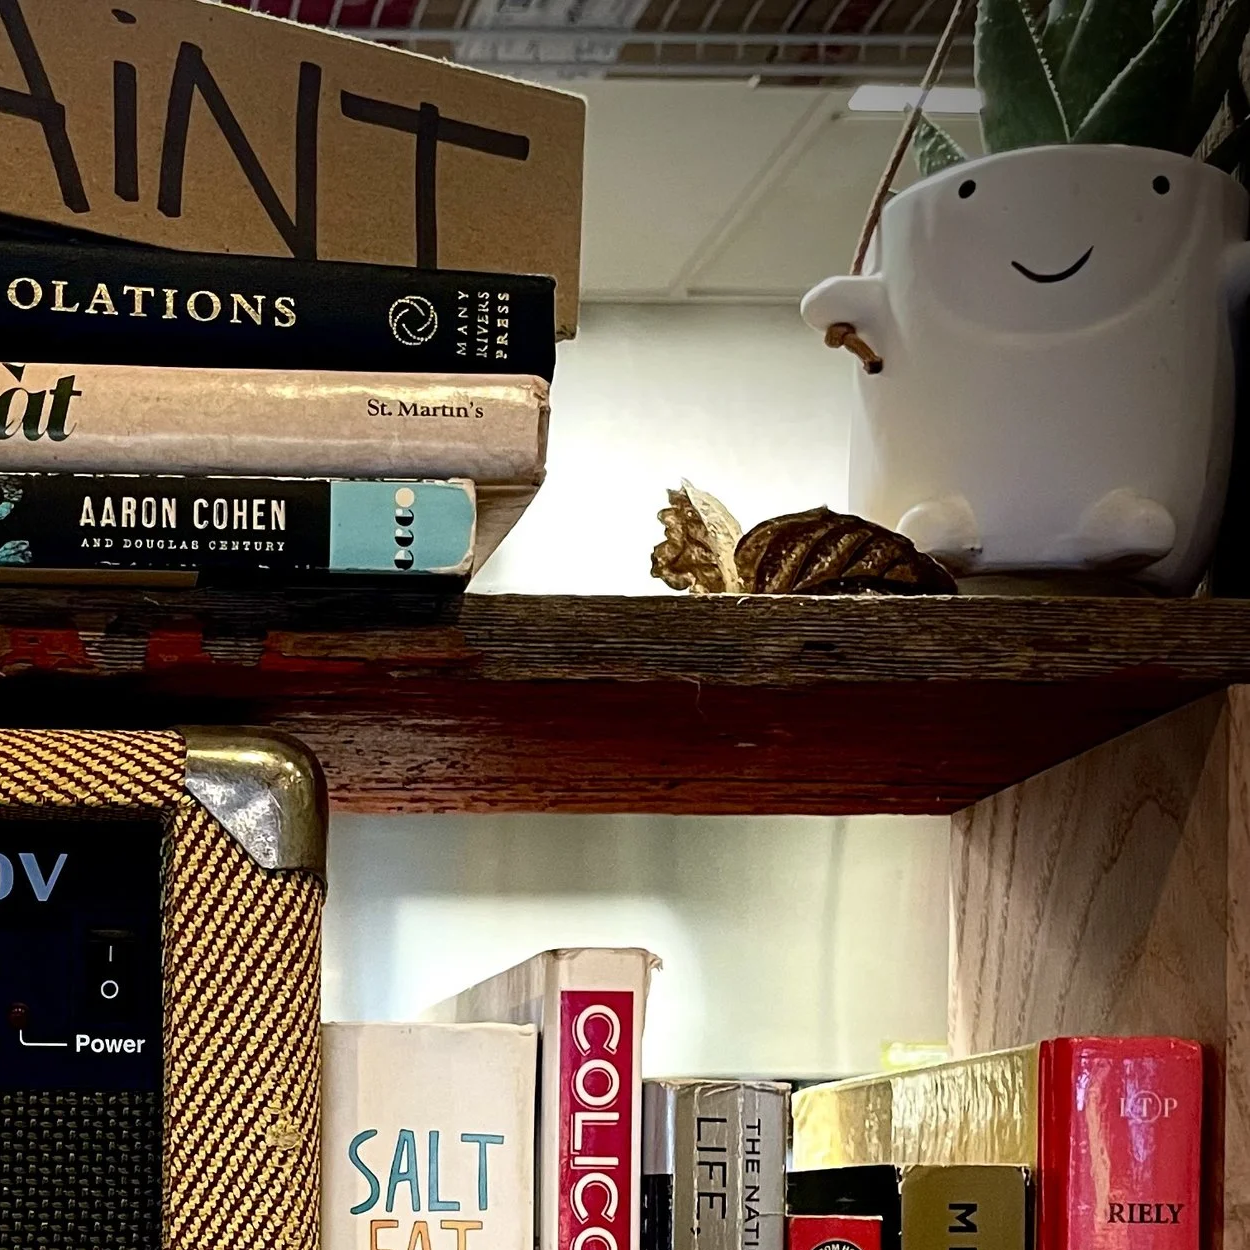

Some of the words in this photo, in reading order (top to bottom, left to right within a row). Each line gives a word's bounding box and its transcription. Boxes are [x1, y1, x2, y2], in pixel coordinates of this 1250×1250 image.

[456, 290, 469, 356] MANY
[476, 291, 490, 358] RIVERS
[496, 292, 510, 359] PRESS
[367, 398, 393, 417] St.
[398, 401, 484, 418] Martin's
[79, 496, 177, 530] AARON
[193, 497, 287, 531] COHEN
[81, 538, 114, 549] AND
[123, 539, 199, 550] DOUGLAS
[208, 540, 286, 552] CENTURY
[75, 1034, 146, 1054] Power
[349, 1128, 505, 1215] SALT
[745, 1118, 761, 1174] THE
[690, 1116, 727, 1239] LIFE,
[1107, 1202, 1185, 1224] RIELY
